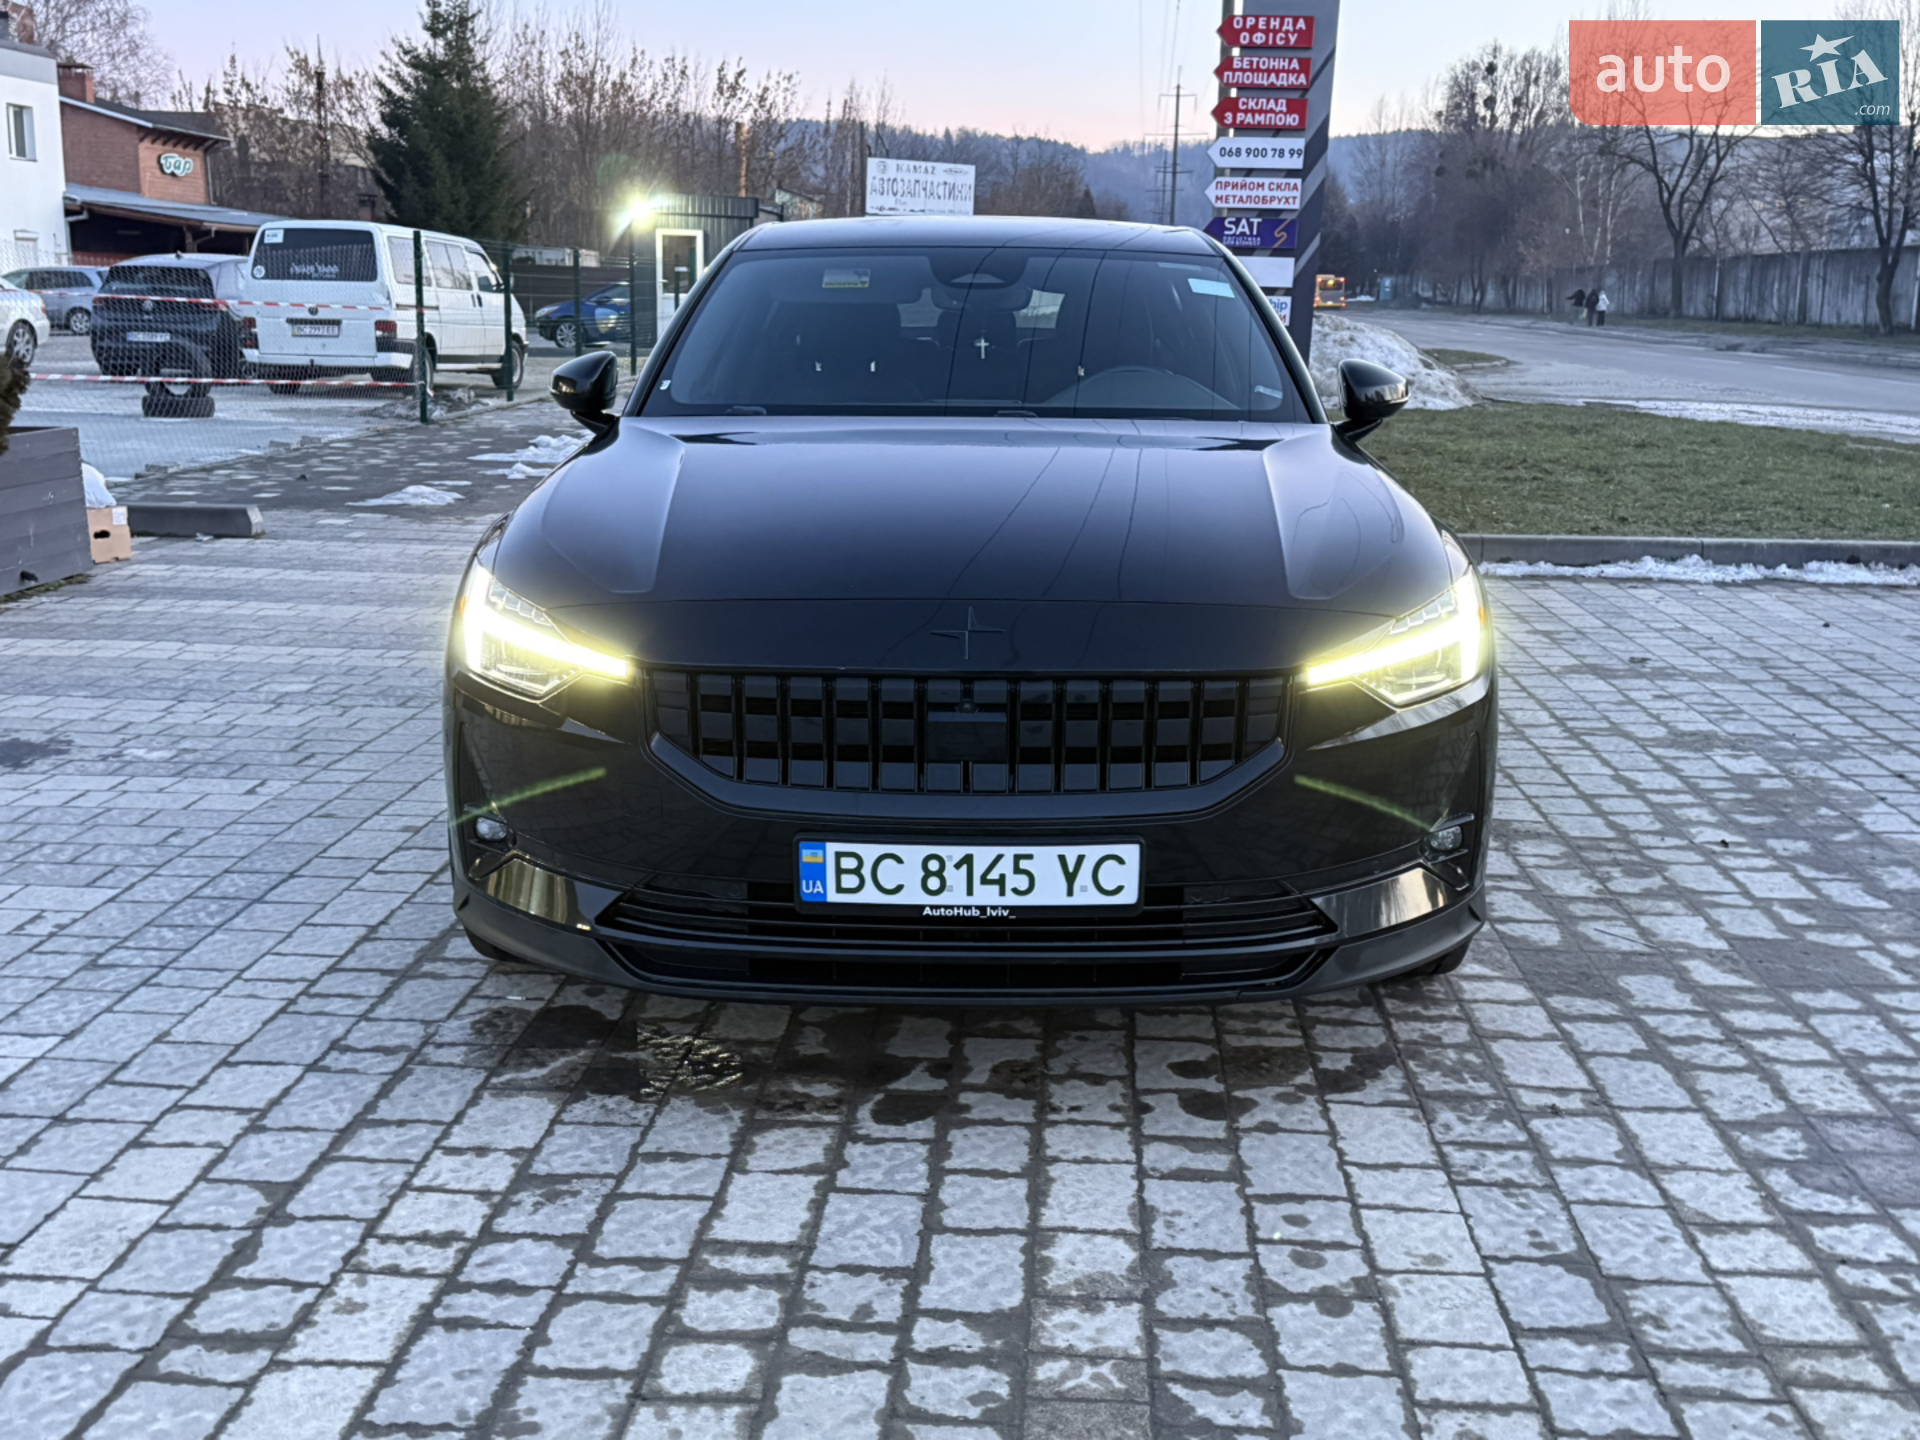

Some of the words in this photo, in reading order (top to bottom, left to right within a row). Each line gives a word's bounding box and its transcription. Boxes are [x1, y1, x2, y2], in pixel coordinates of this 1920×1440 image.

[1233, 17, 1306, 31] ОРЕНДА
[1239, 32, 1298, 45] ОФІСУ
[1232, 57, 1300, 70] БЕТОННА
[1223, 71, 1307, 86] ПЛОЩАДКА
[1238, 98, 1287, 112] СКЛАД
[1236, 113, 1299, 126] РАМПОЮ
[1219, 147, 1242, 158] 068
[1245, 147, 1268, 158] 900
[870, 176, 972, 202] АВТОЗАПЧАСТИНИ
[1215, 180, 1265, 191] ПРИЙОМ
[1268, 182, 1299, 192] СКЛА
[1215, 195, 1298, 206] МЕТАЛОБРУХТ
[1223, 217, 1262, 235] SAT
[834, 851, 905, 896] BC
[920, 853, 1036, 897] 8145
[1057, 853, 1126, 897] YC
[802, 880, 824, 895] UA
